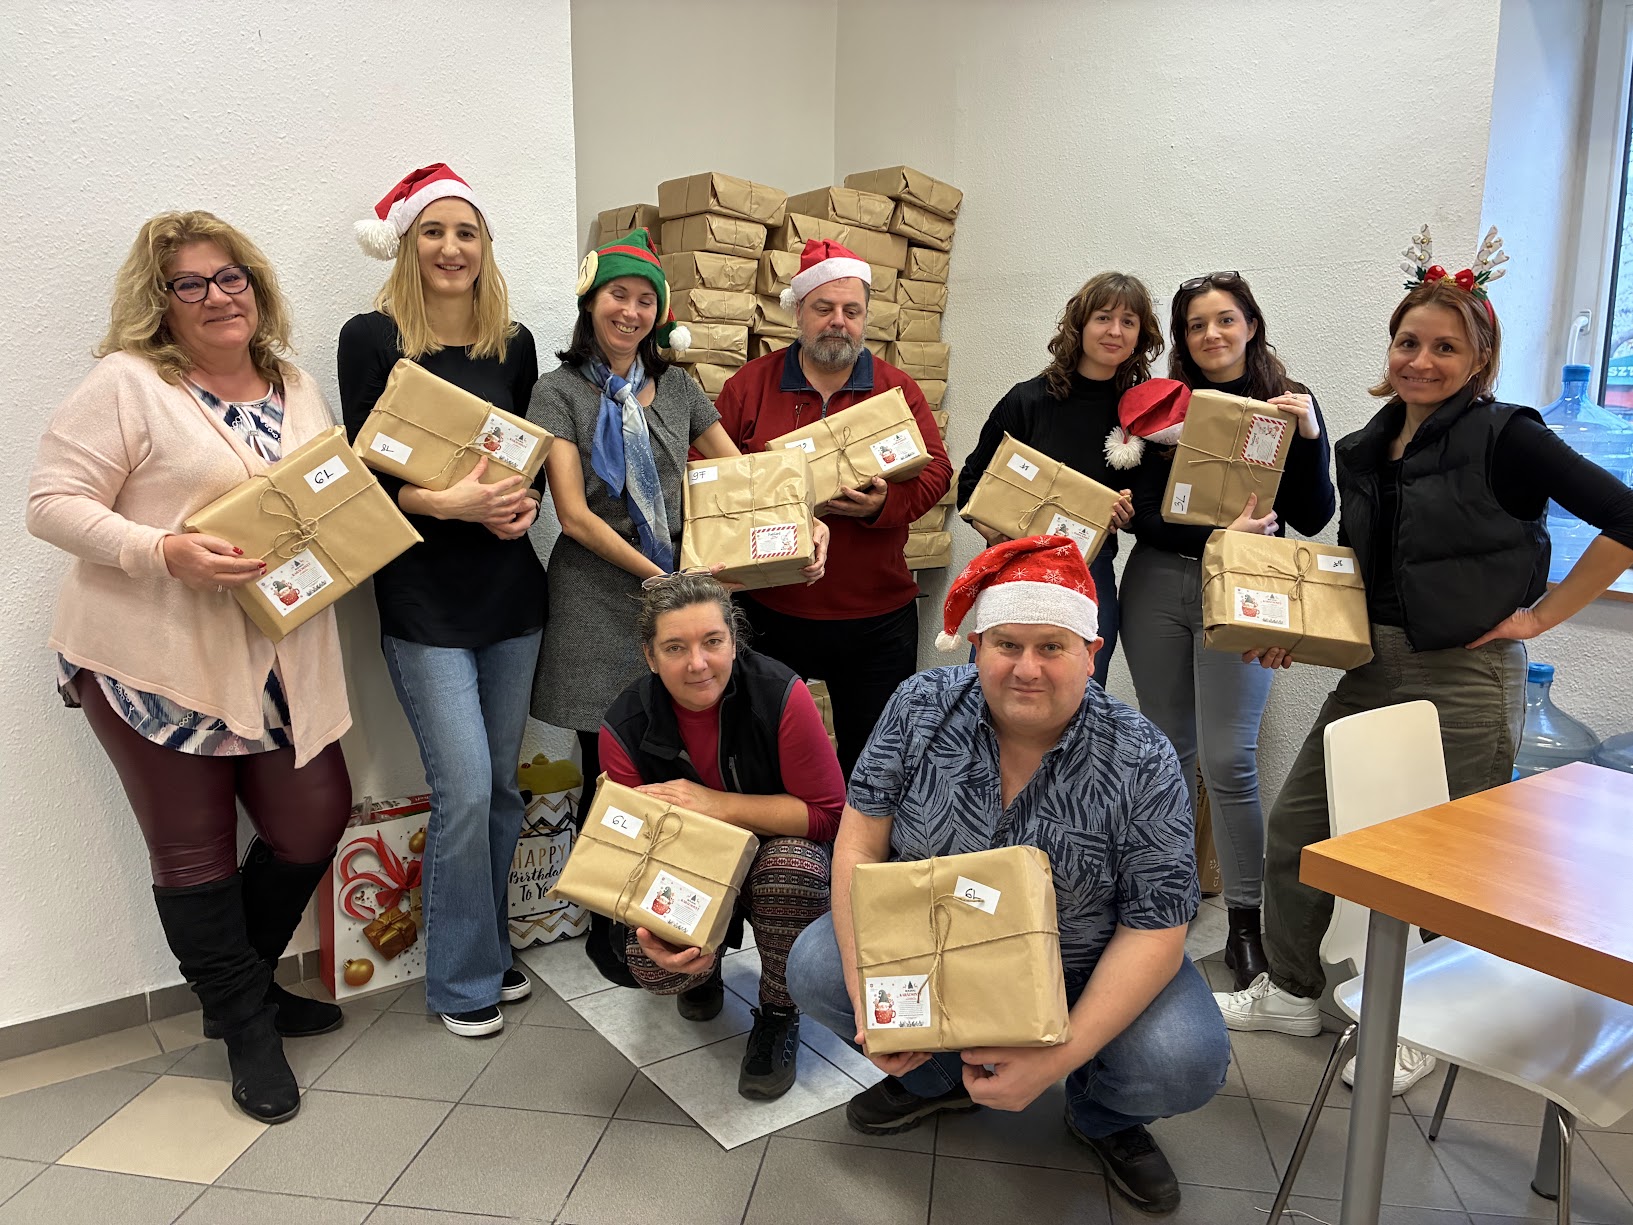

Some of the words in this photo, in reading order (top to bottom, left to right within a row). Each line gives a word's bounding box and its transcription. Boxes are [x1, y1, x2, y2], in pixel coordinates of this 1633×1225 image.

[512, 843, 566, 870] HAPPY
[509, 865, 563, 885] Birthda
[520, 884, 533, 902] To
[535, 881, 553, 900] Yo
